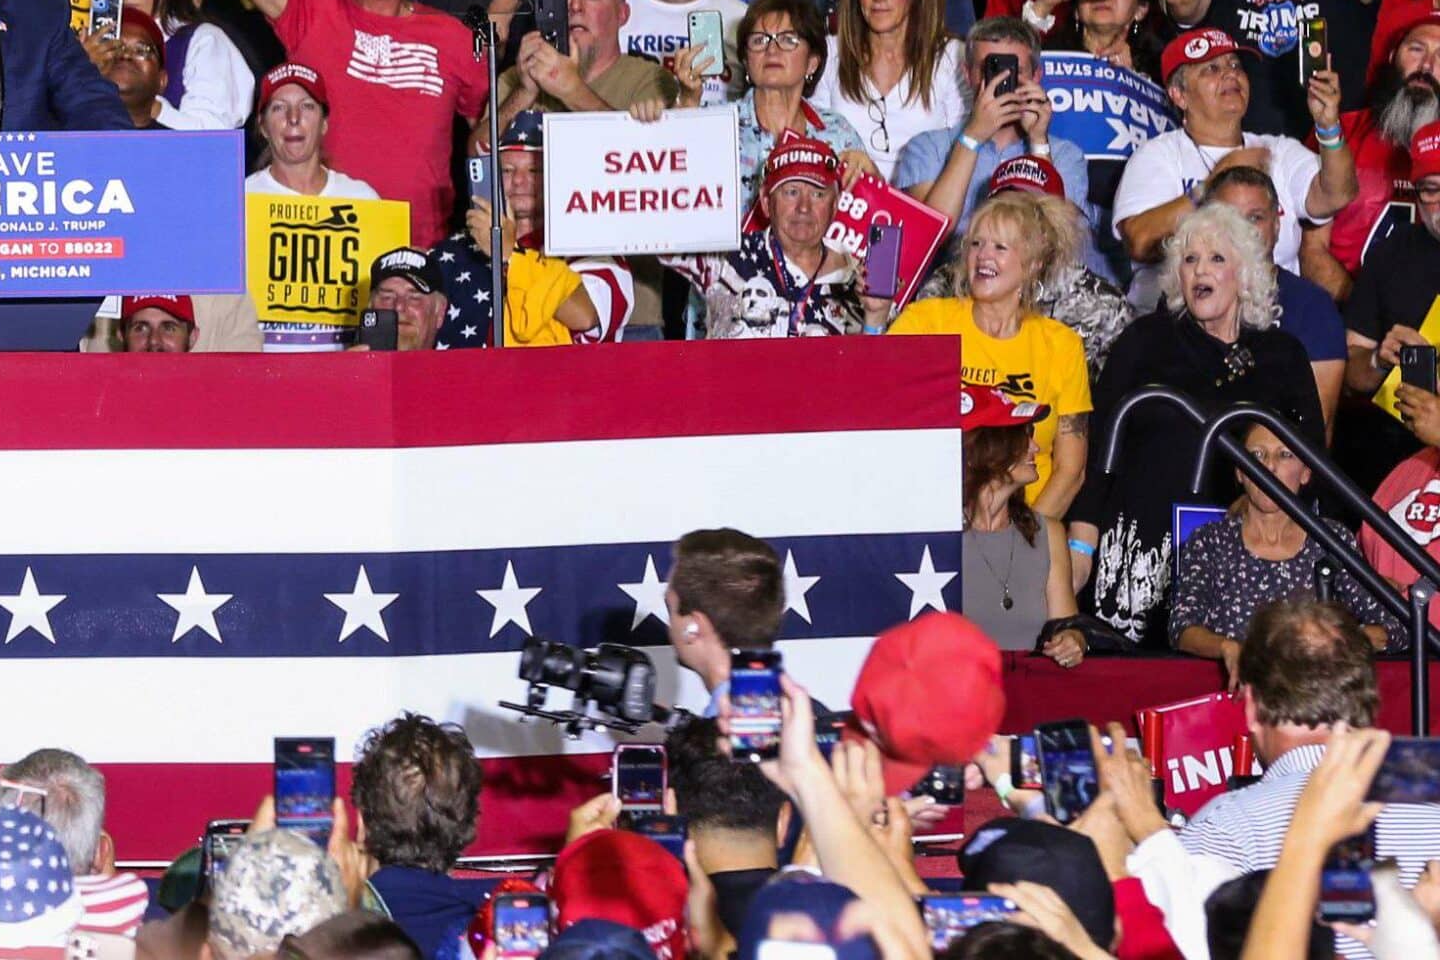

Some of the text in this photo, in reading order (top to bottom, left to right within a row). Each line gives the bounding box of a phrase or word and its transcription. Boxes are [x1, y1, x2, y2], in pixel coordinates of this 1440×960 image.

[627, 34, 690, 53] KRIST
[1044, 60, 1104, 79] STATE OF
[1051, 88, 1175, 132] ARAMO
[604, 149, 688, 174] SAVE
[772, 150, 824, 169] TRUMP
[565, 187, 724, 214] AMERICA!
[269, 203, 319, 221] PROTECT
[48, 221, 59, 232] J.
[63, 220, 106, 231] TRUMP
[40, 243, 60, 255] TO
[65, 242, 114, 254] 88022
[268, 231, 360, 287] GIRLS
[380, 251, 427, 270] TRUMP
[11, 266, 91, 279] MICHIGAN
[266, 283, 359, 307] SPORTS
[961, 368, 997, 384] OTECT
[1408, 502, 1440, 523] RE
